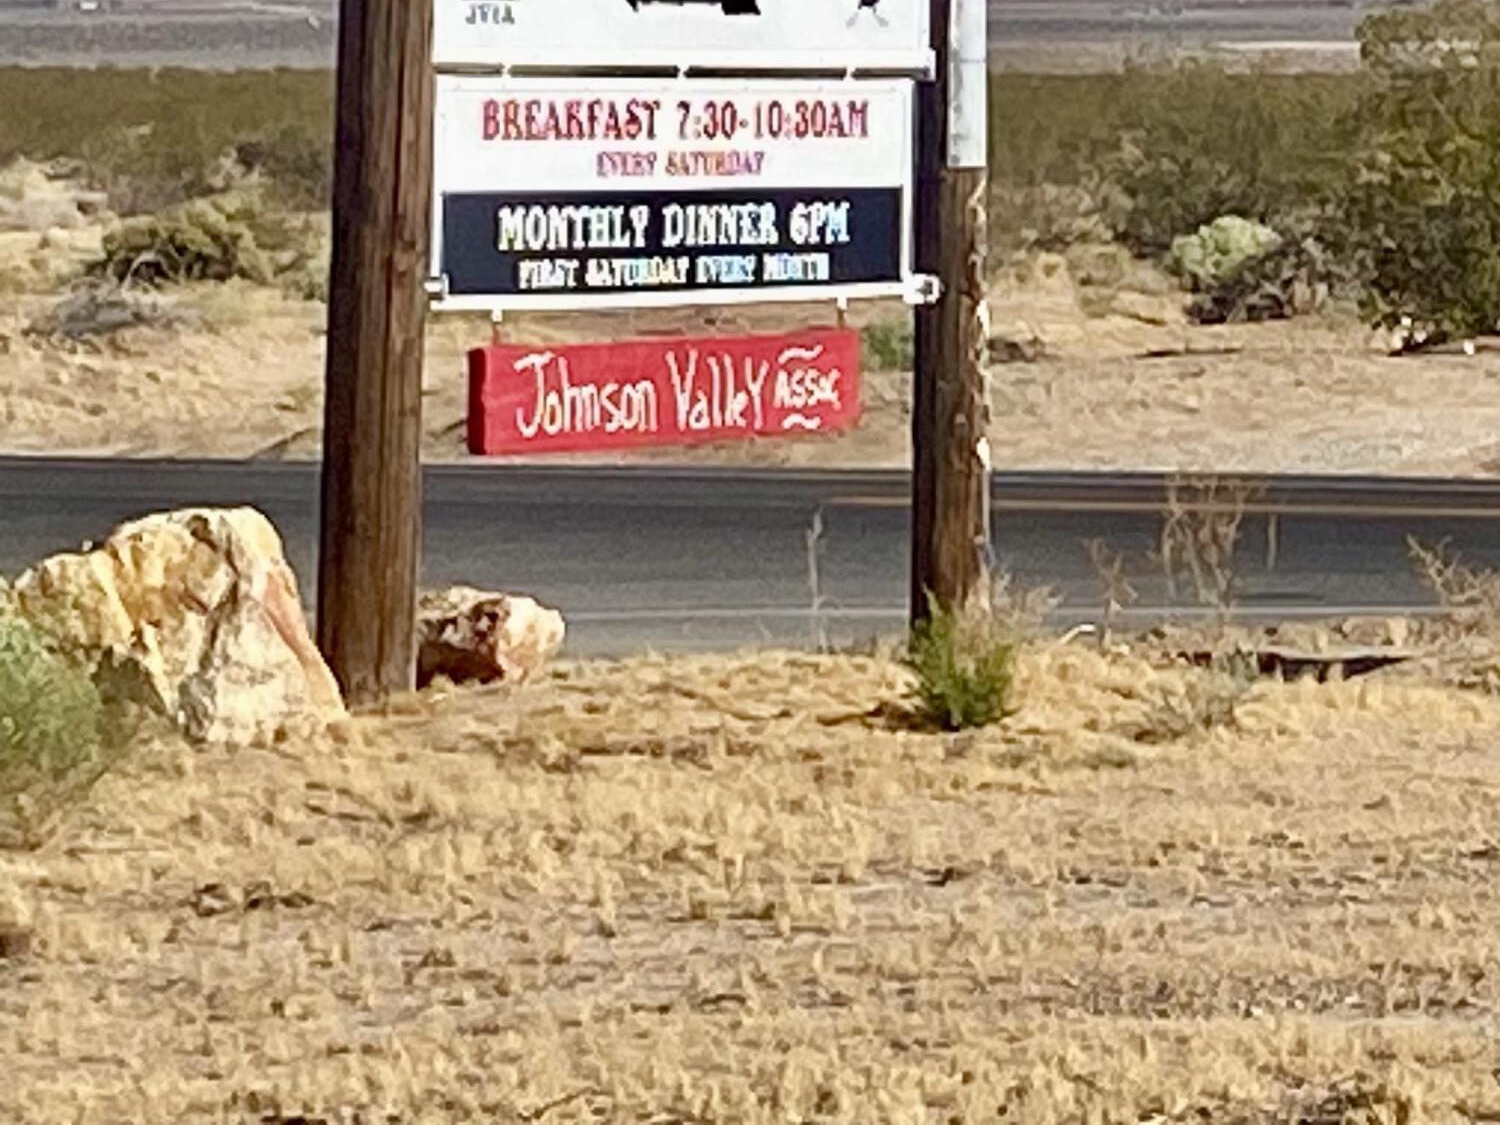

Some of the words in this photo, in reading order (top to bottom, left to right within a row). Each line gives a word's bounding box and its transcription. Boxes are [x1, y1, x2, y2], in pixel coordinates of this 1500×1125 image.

[482, 98, 660, 141] BREAKFAST
[676, 100, 869, 139] 7:30-10:30AM
[597, 151, 657, 177] EVERY
[664, 150, 764, 176] SATURDAY
[498, 205, 648, 251] MONTHLY
[662, 202, 779, 247] DINNER
[790, 201, 850, 245] 6PM
[519, 258, 579, 289] FIRST
[586, 255, 690, 287] SATURDAY
[696, 253, 755, 284] EVERY
[763, 253, 829, 281] MONTH
[514, 350, 658, 438] Johnson
